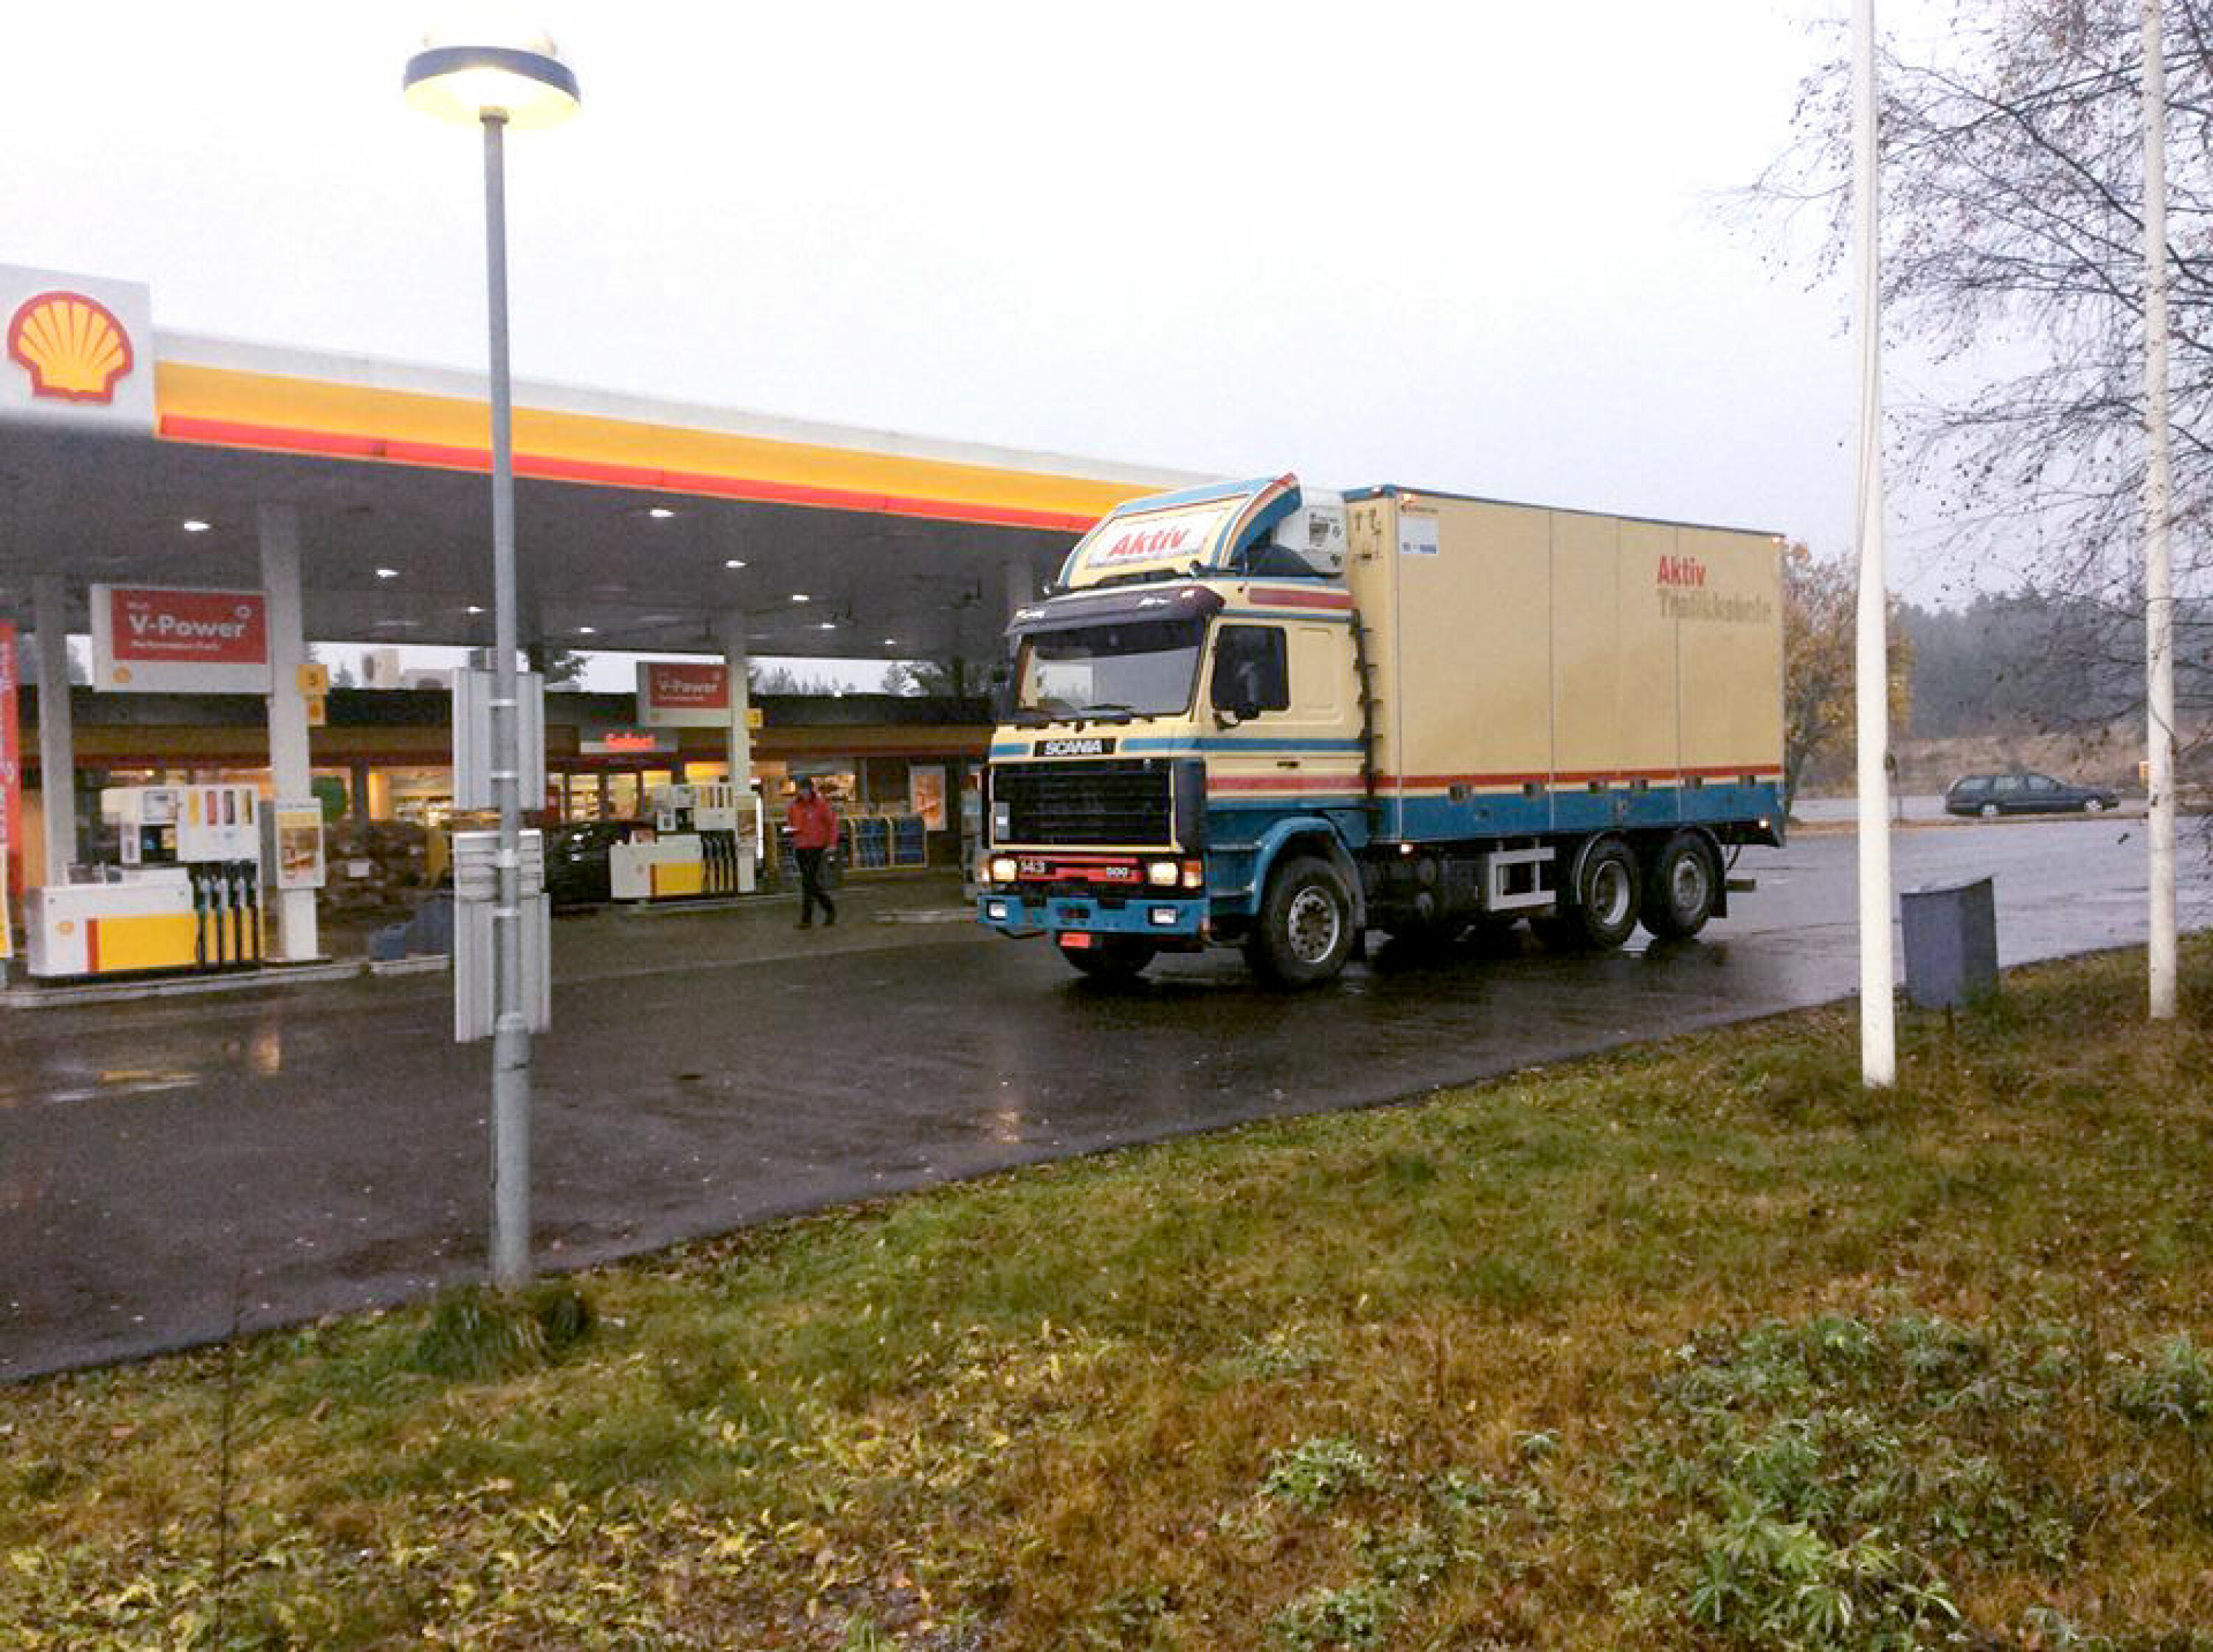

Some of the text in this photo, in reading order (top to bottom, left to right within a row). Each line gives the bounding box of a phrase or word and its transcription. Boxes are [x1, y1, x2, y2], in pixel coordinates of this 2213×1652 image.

[1109, 526, 1190, 556] Aktiv
[1657, 555, 1706, 587] Aktiv
[128, 614, 246, 638] V-Power
[1045, 740, 1102, 754] SCANIA
